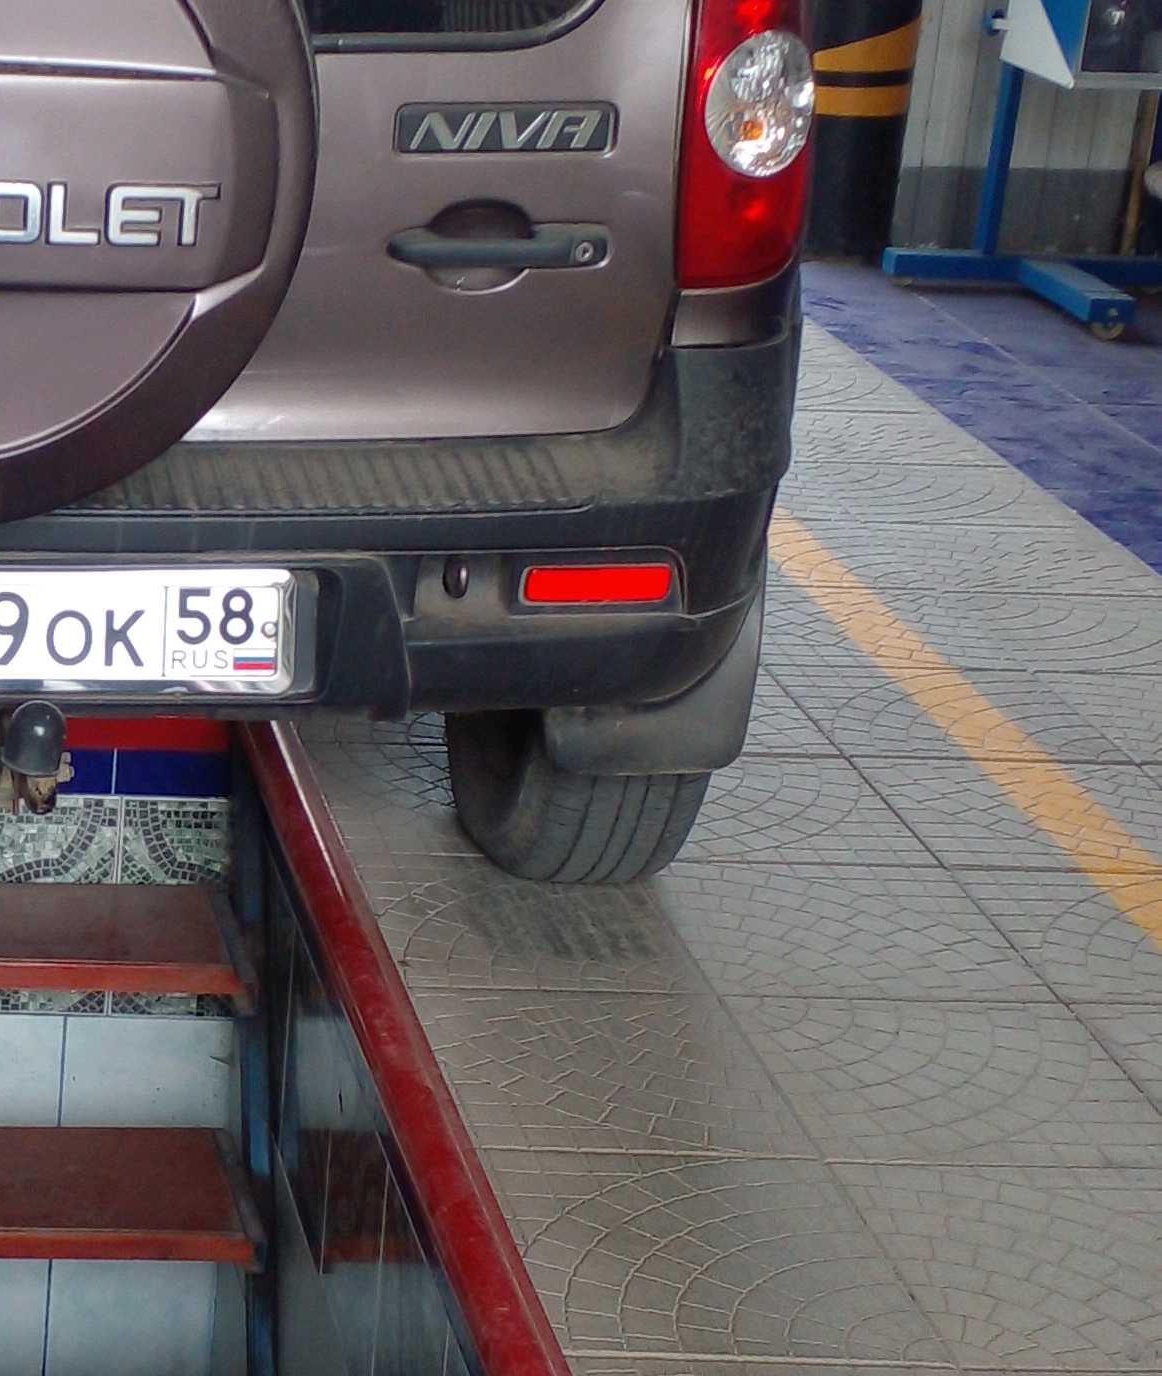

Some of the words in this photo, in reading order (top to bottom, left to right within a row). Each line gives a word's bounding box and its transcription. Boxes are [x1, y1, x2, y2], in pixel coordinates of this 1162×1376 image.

[409, 110, 603, 150] NIVA
[175, 588, 255, 645] 58
[170, 649, 229, 671] RUS
